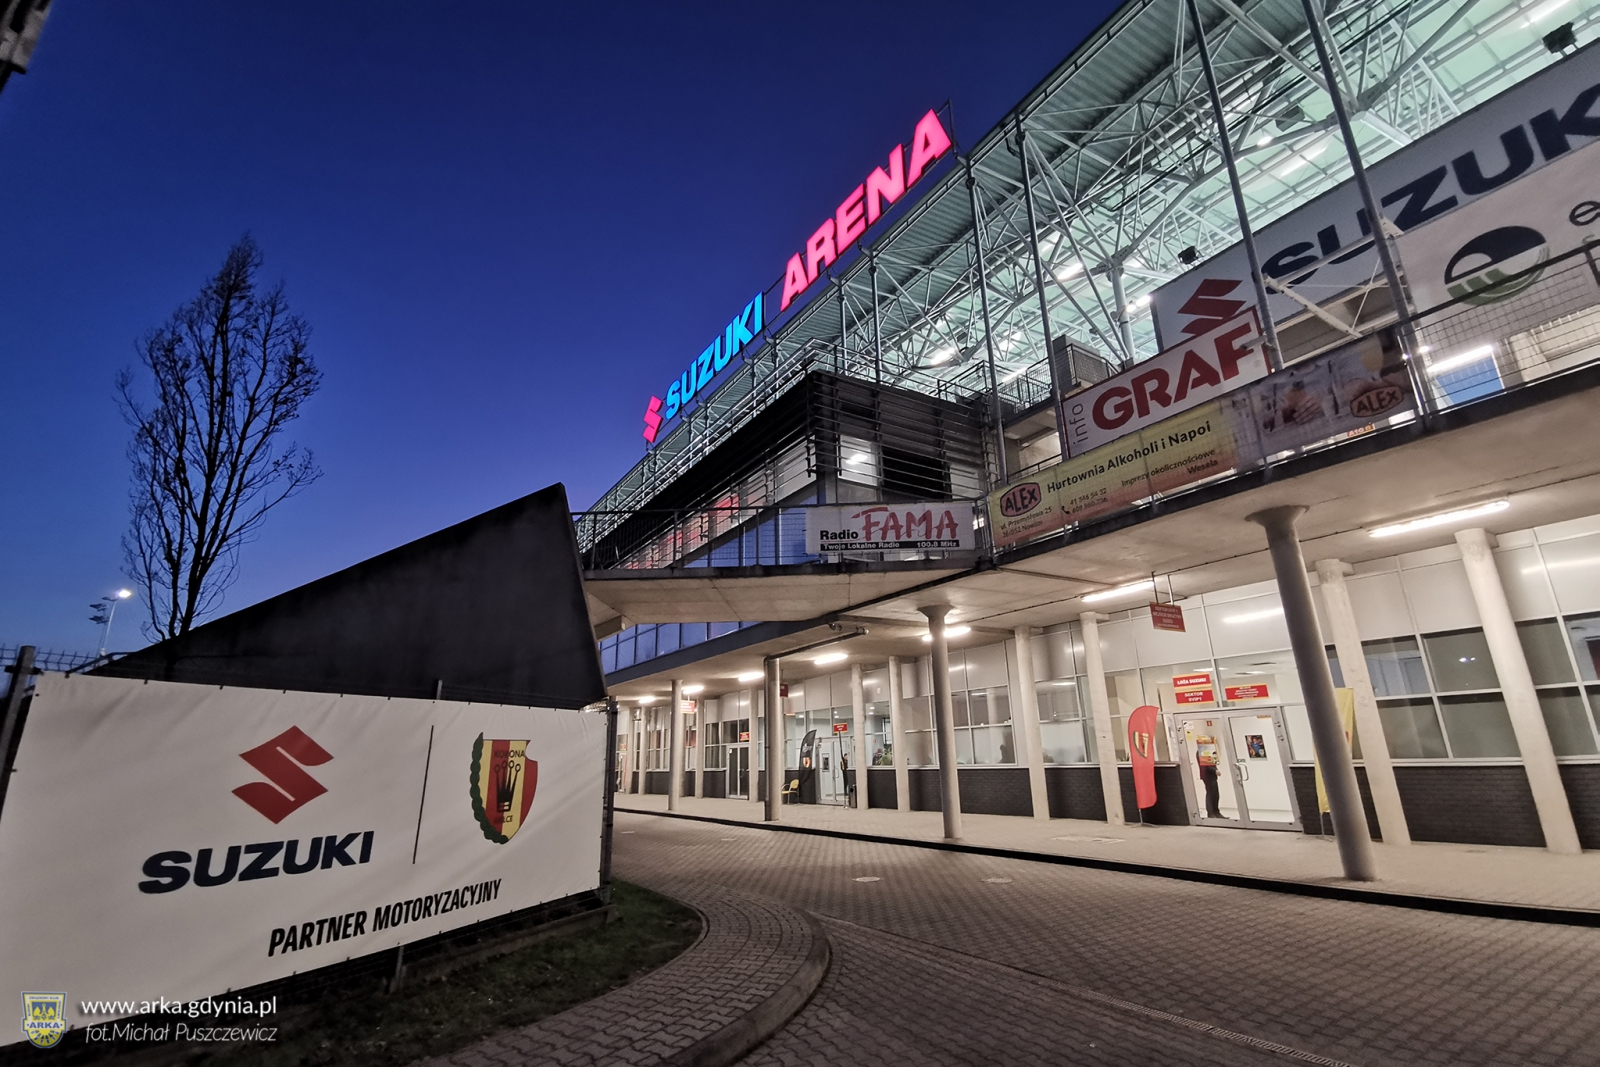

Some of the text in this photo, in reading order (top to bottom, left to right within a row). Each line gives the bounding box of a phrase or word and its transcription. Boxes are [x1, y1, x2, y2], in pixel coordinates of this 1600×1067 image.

[665, 108, 951, 420] SUZUKI ARENA
[1092, 322, 1255, 430] GRAF
[1356, 390, 1399, 414] ALEX
[1069, 403, 1089, 445] info
[1047, 421, 1212, 494] Hurtownia Alkoholi i Napoi
[1121, 449, 1216, 487] Imprezy okolicznościowe
[1187, 459, 1219, 474] Wesela
[1005, 487, 1038, 513] ALEX
[820, 506, 959, 541] Radio FAMA
[823, 543, 846, 551] Twoje
[878, 541, 900, 549] Radio
[138, 831, 374, 894] SUZUKI
[268, 878, 502, 957] PARTNER MOTORYZACYJNY
